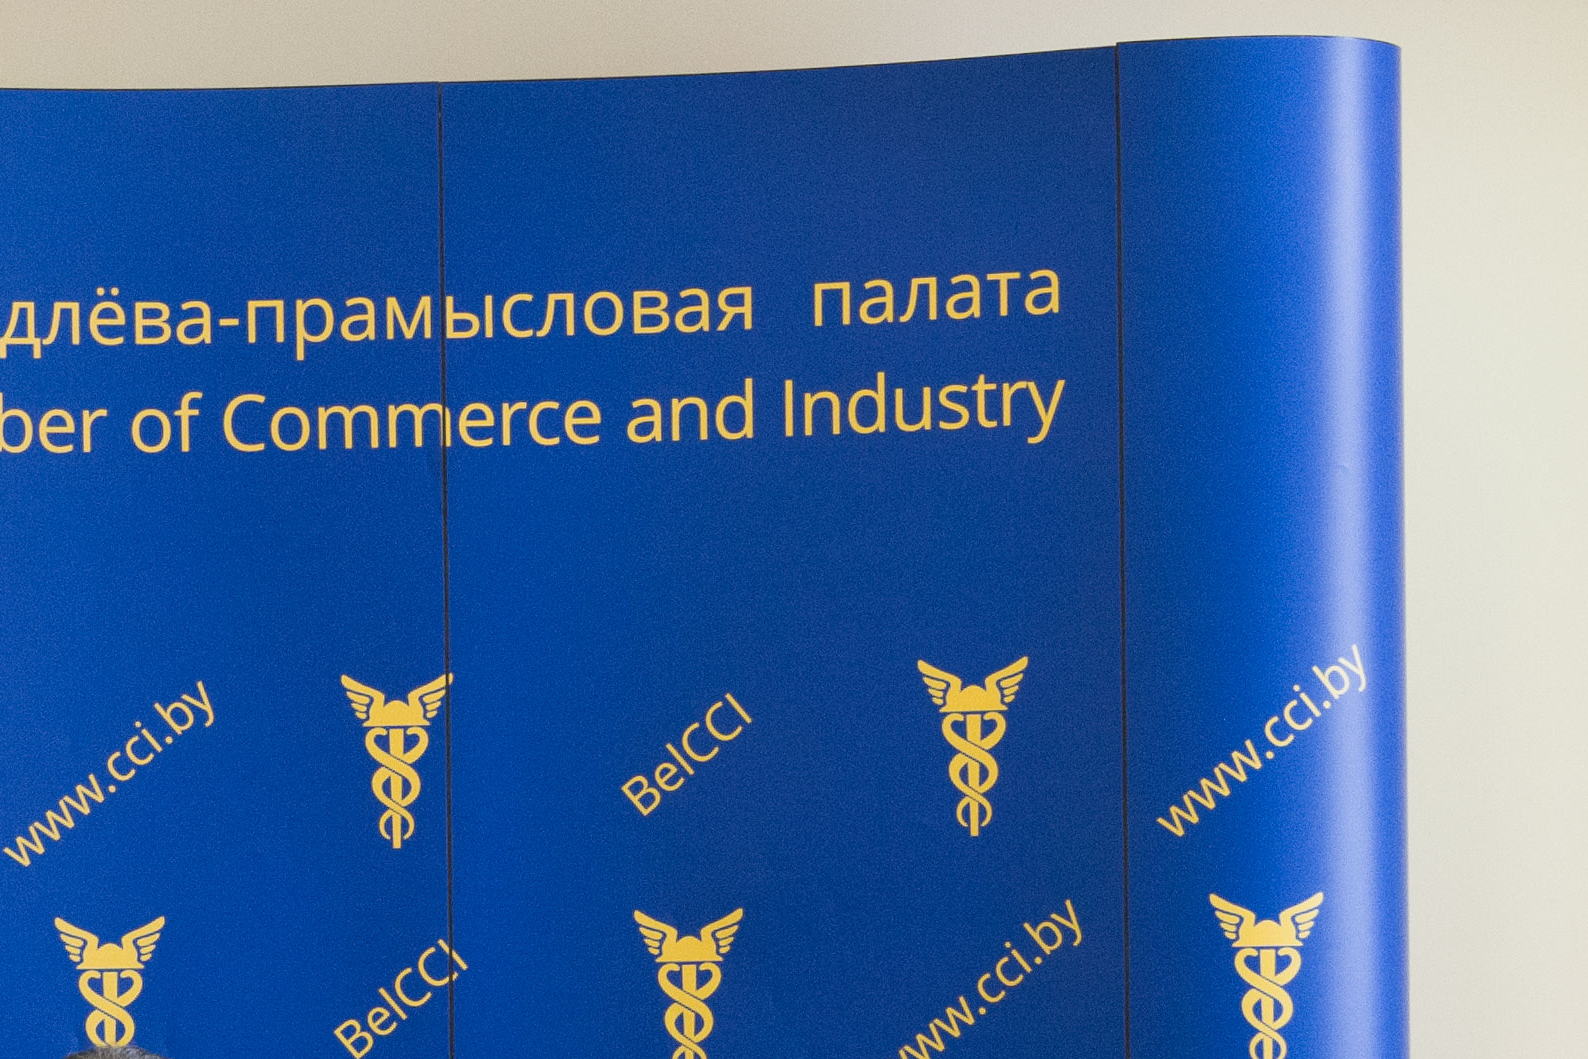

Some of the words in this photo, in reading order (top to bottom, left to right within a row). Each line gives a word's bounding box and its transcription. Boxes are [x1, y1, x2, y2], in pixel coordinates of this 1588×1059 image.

[813, 268, 1061, 327] палата
[130, 391, 204, 454] of
[222, 392, 603, 454] Commerce
[625, 376, 755, 444] and
[783, 370, 1067, 445] Industry
[2, 679, 216, 867] www.cci.by
[620, 691, 753, 817] BelCCI
[1155, 643, 1368, 838] www.cci.by
